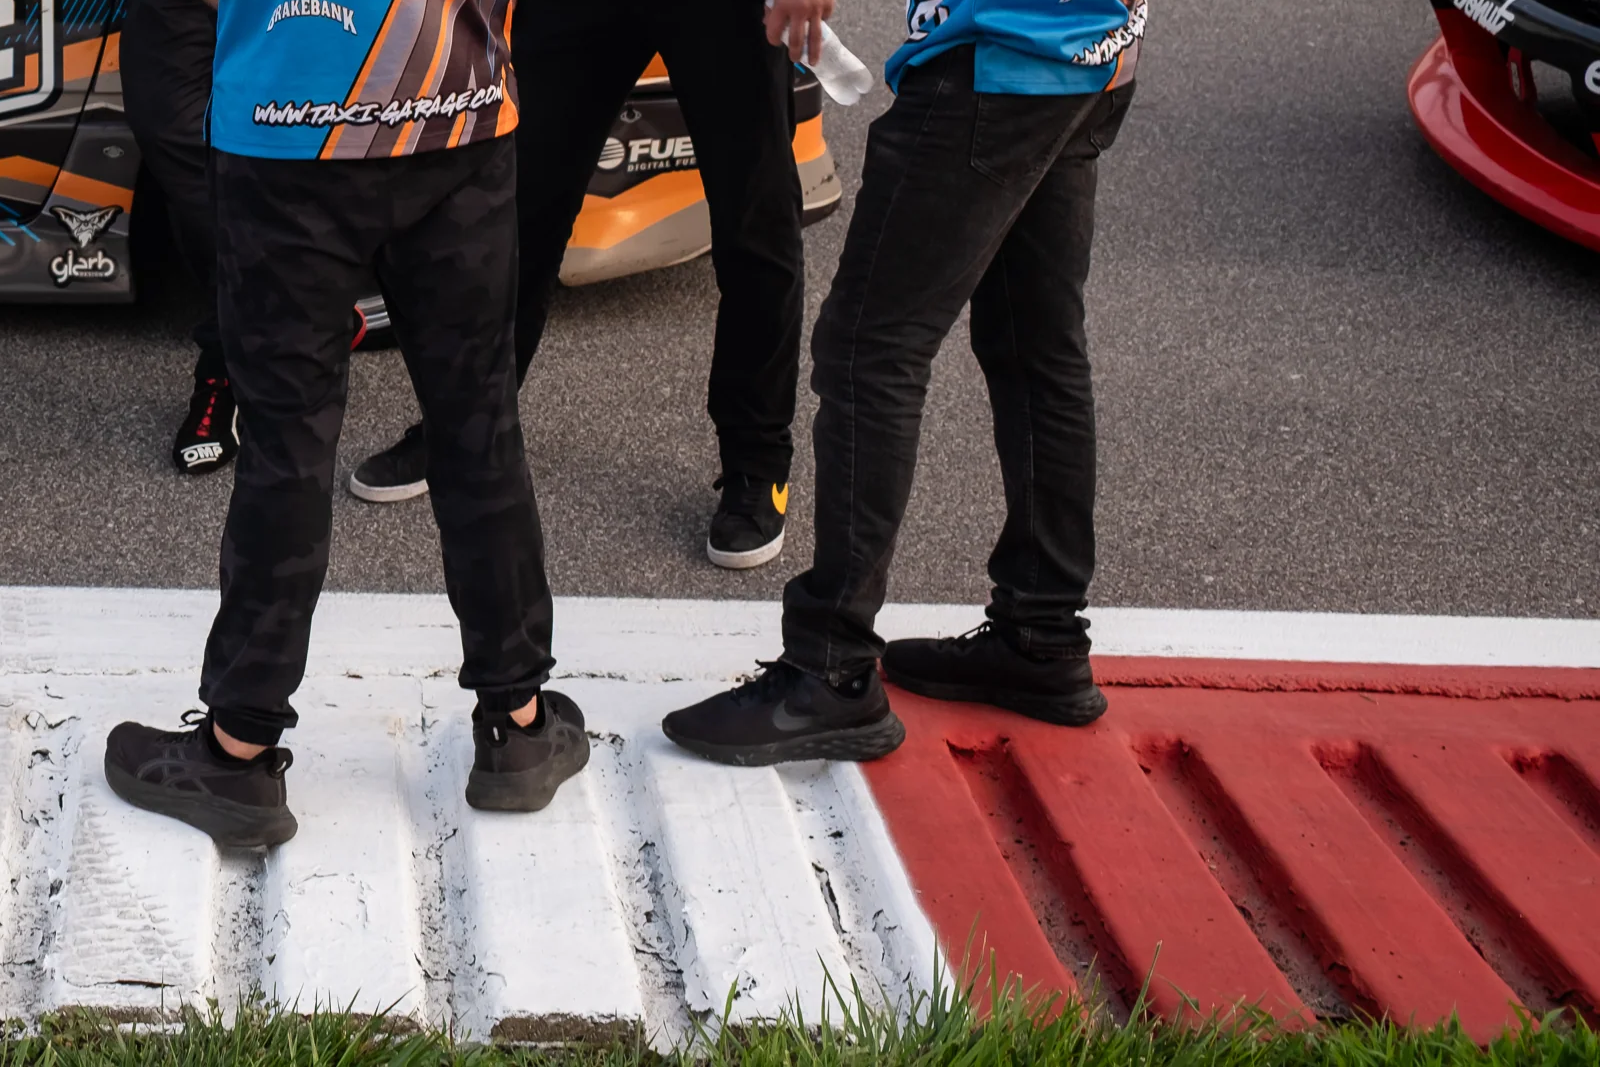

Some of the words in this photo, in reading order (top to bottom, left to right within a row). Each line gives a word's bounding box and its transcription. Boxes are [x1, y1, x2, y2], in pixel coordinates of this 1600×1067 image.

[627, 161, 671, 172] DIGITAL
[675, 157, 697, 168] FUE
[183, 446, 223, 463] OMP
